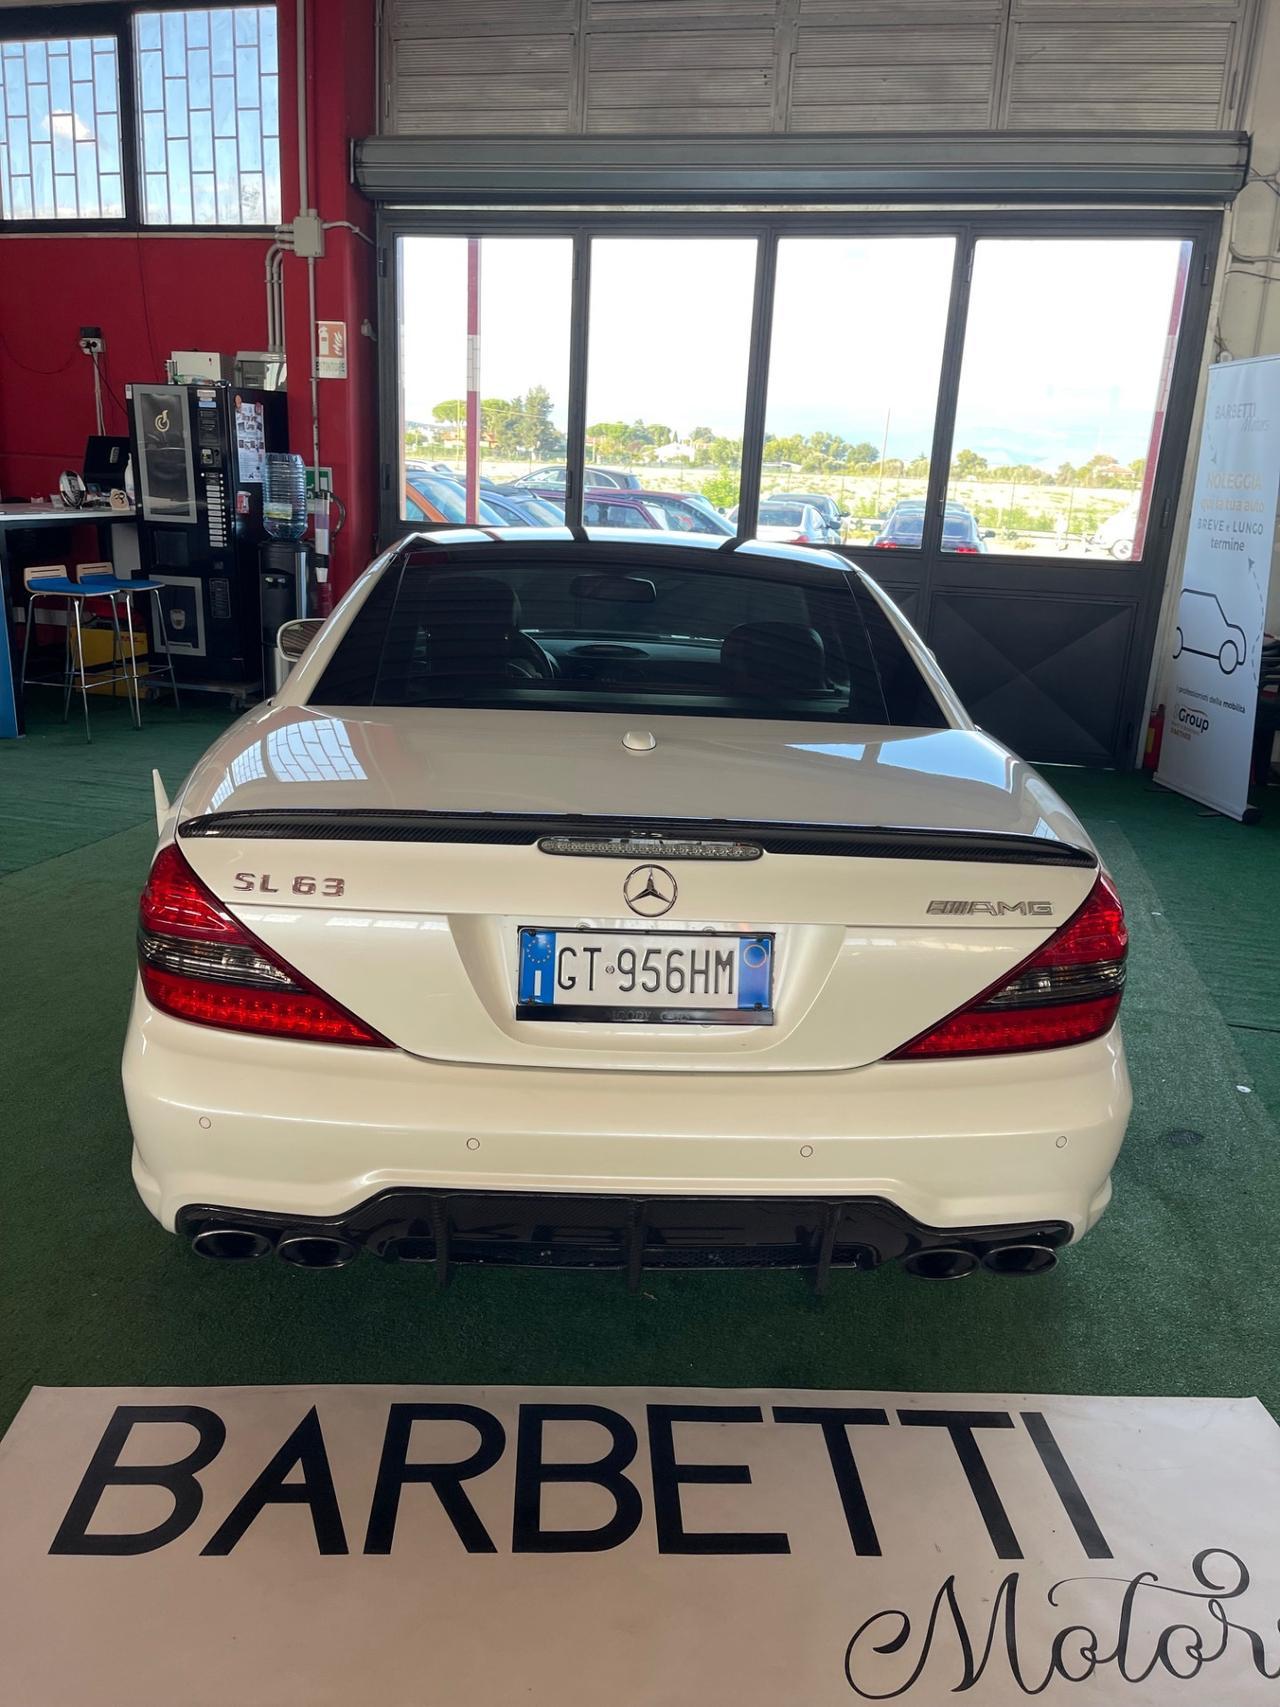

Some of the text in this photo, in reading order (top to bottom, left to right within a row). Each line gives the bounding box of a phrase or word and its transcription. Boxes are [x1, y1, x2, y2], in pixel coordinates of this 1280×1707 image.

[1197, 518, 1224, 532] BREVE
[1233, 521, 1264, 535] LUNGO
[1211, 537, 1245, 552] termine
[1178, 707, 1209, 733] Group
[233, 872, 345, 897] SL 63
[966, 900, 1053, 917] AMG
[557, 946, 735, 995] GT 956HM
[48, 1404, 1114, 1559] BARBETTI
[845, 1549, 1280, 1699] Motor
